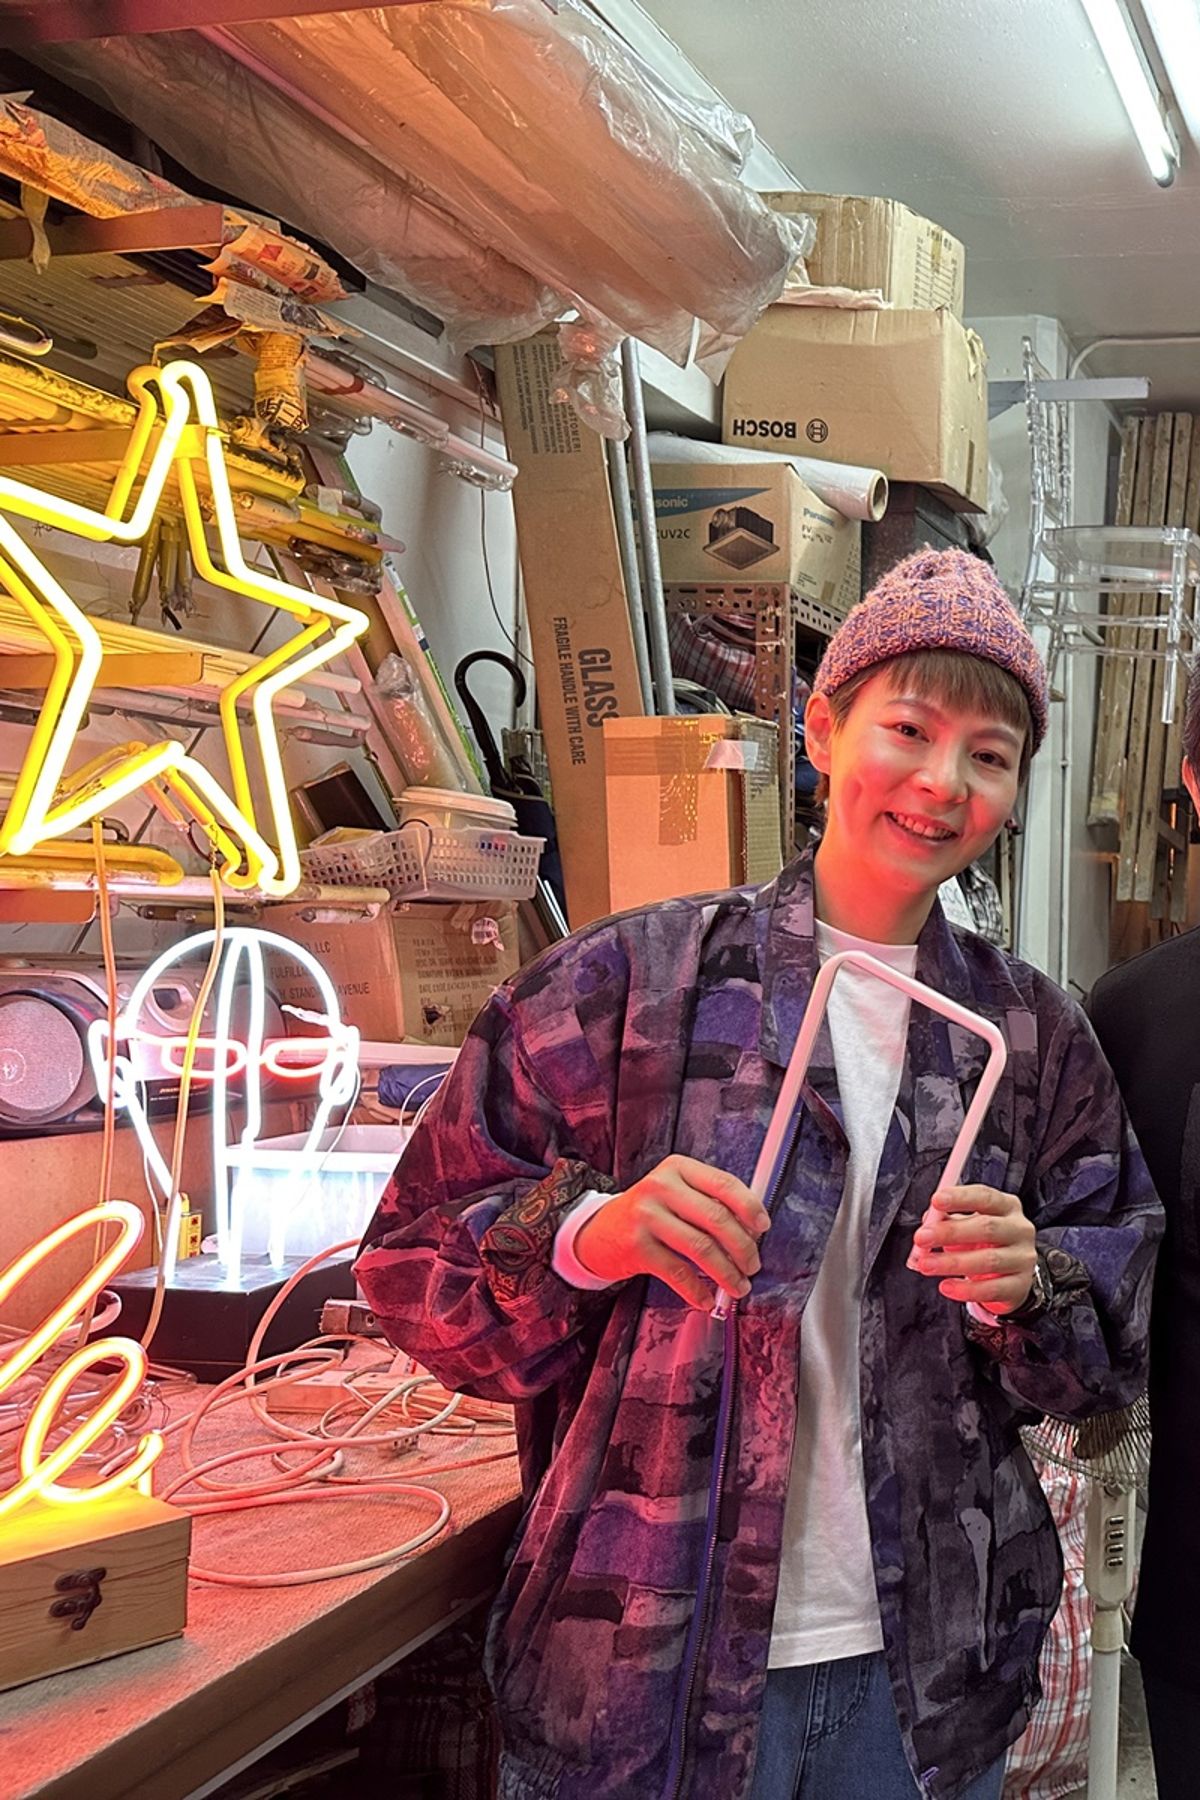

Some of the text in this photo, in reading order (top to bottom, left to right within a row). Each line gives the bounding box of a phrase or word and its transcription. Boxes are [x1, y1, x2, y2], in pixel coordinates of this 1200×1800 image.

[568, 405, 581, 454] USTOMER!
[733, 419, 797, 439] BOSCH
[655, 496, 689, 508] sonic
[553, 617, 586, 766] FRAGILE HANDLE WITH CARE
[578, 648, 620, 728] GLASS
[270, 966, 306, 979] FULFILL
